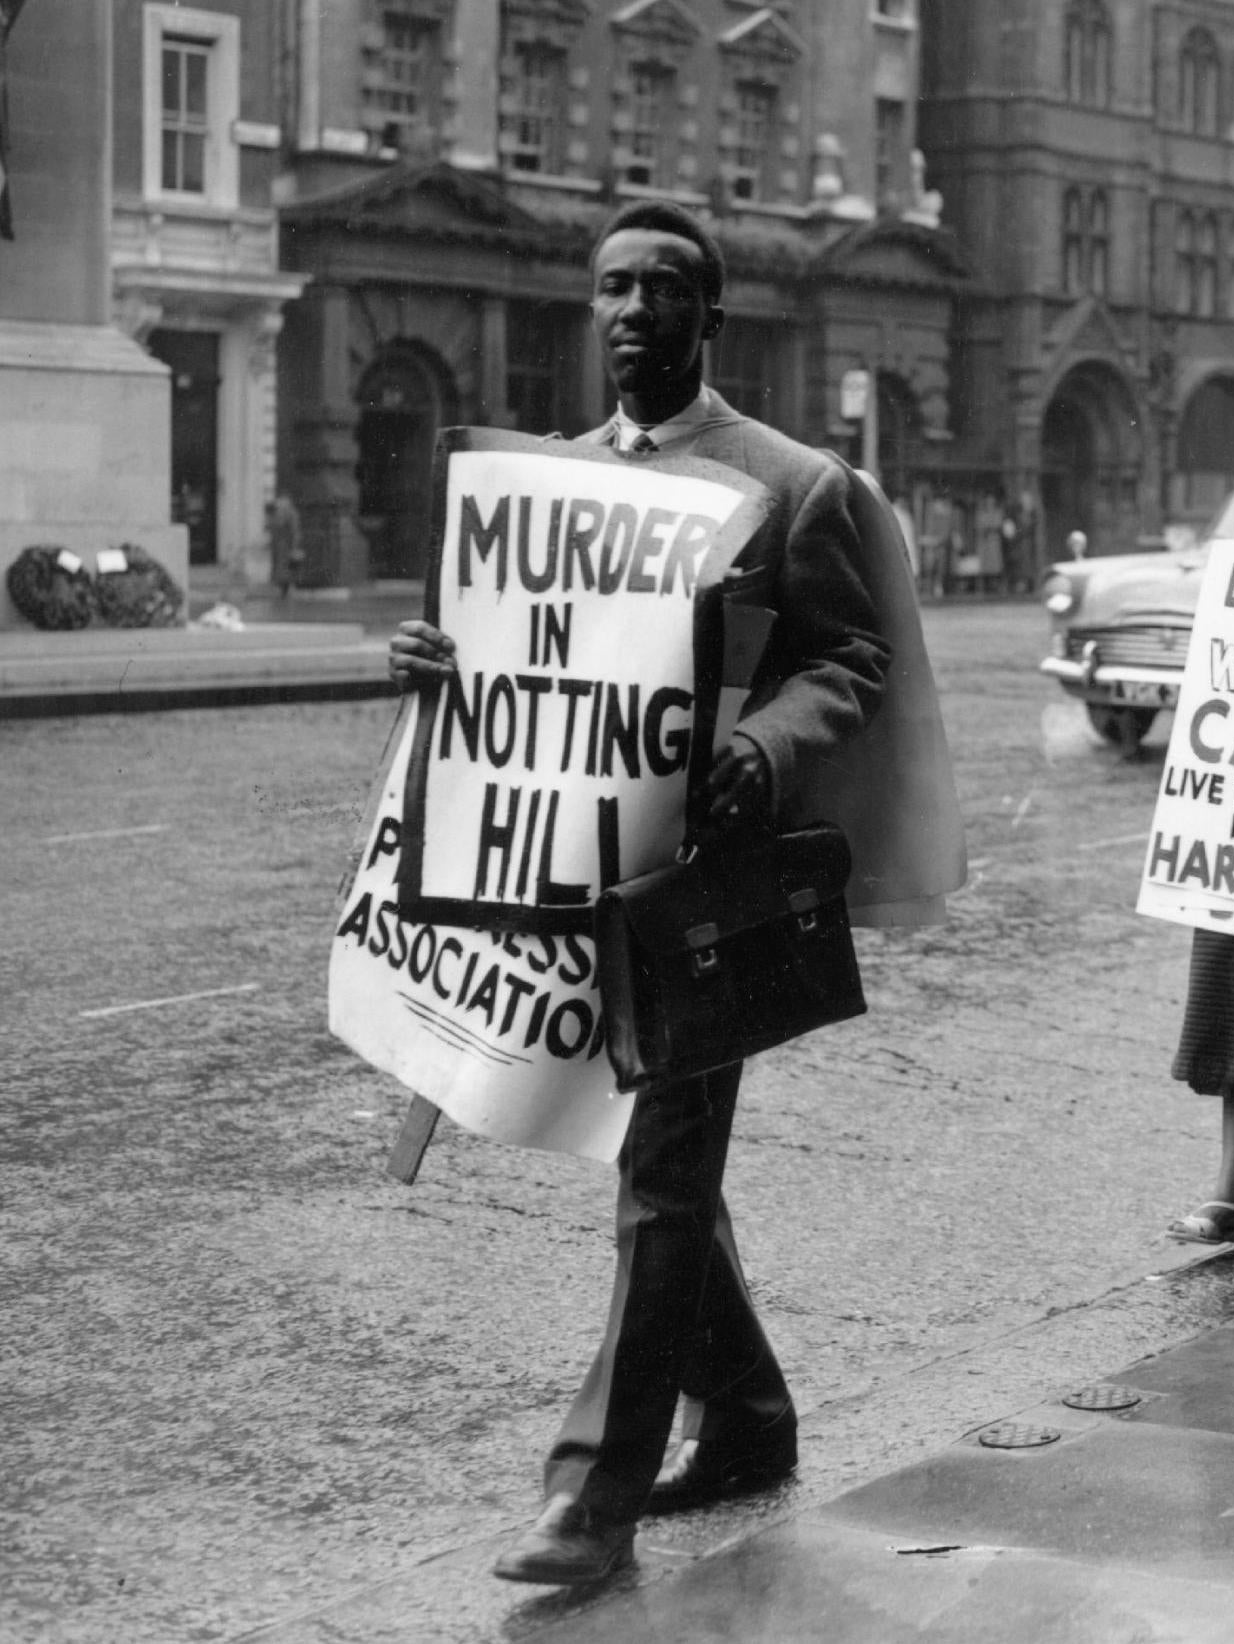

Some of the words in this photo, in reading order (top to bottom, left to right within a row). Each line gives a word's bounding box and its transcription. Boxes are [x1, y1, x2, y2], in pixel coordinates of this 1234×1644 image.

[457, 494, 717, 601] MURDER
[529, 602, 572, 669] IN
[439, 671, 694, 779] NOTTING
[1164, 765, 1226, 806] LIVE
